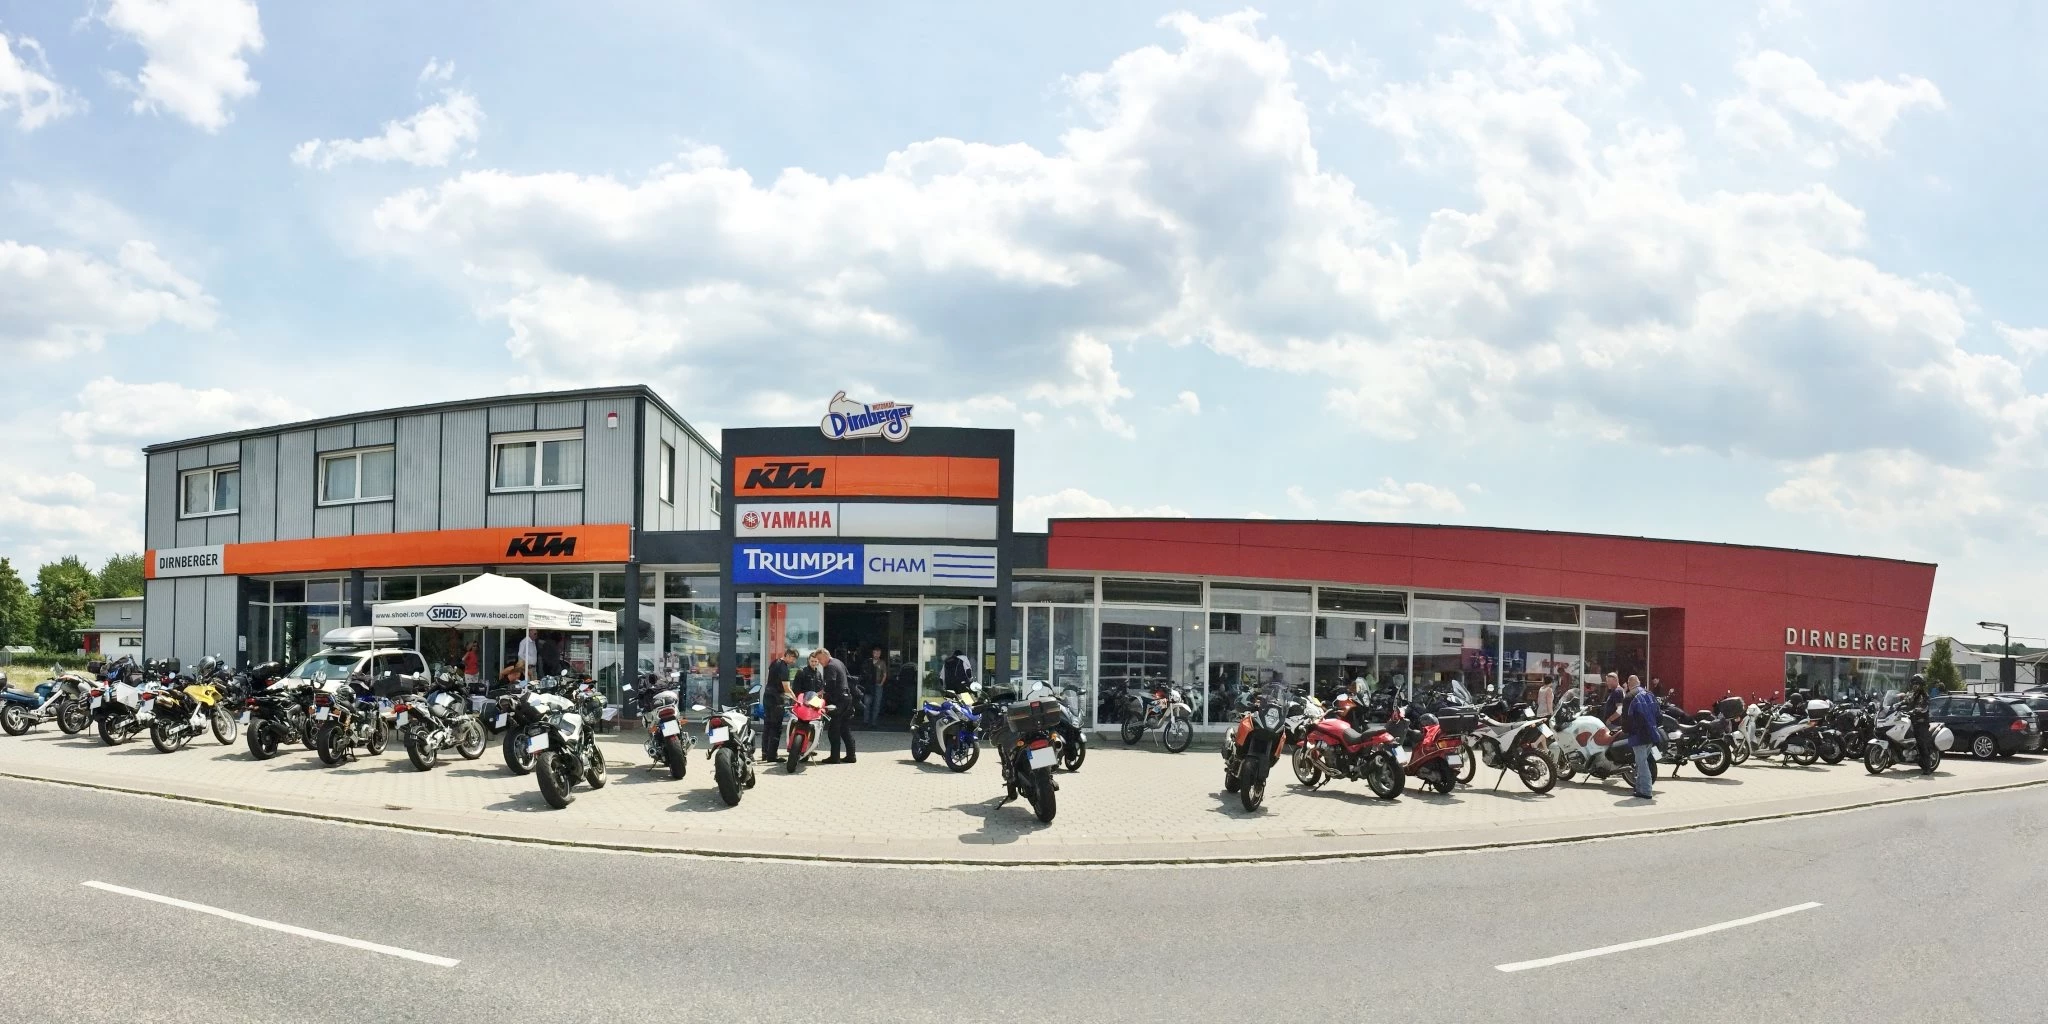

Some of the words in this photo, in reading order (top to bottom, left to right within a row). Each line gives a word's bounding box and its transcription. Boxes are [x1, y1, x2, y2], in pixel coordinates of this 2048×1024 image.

[830, 404, 913, 437] Dirnberger
[743, 462, 826, 489] KTM
[760, 511, 832, 529] YAMAHA
[505, 532, 577, 557] KTM
[159, 553, 218, 569] DIRNBERGER
[743, 548, 854, 580] TRIUMPH
[868, 557, 926, 573] CHAM
[375, 611, 425, 619] www.shoei.com
[432, 608, 462, 619] SHOEI
[470, 610, 525, 619] www.shoei.com
[1785, 627, 1911, 653] DIRNBERGER
